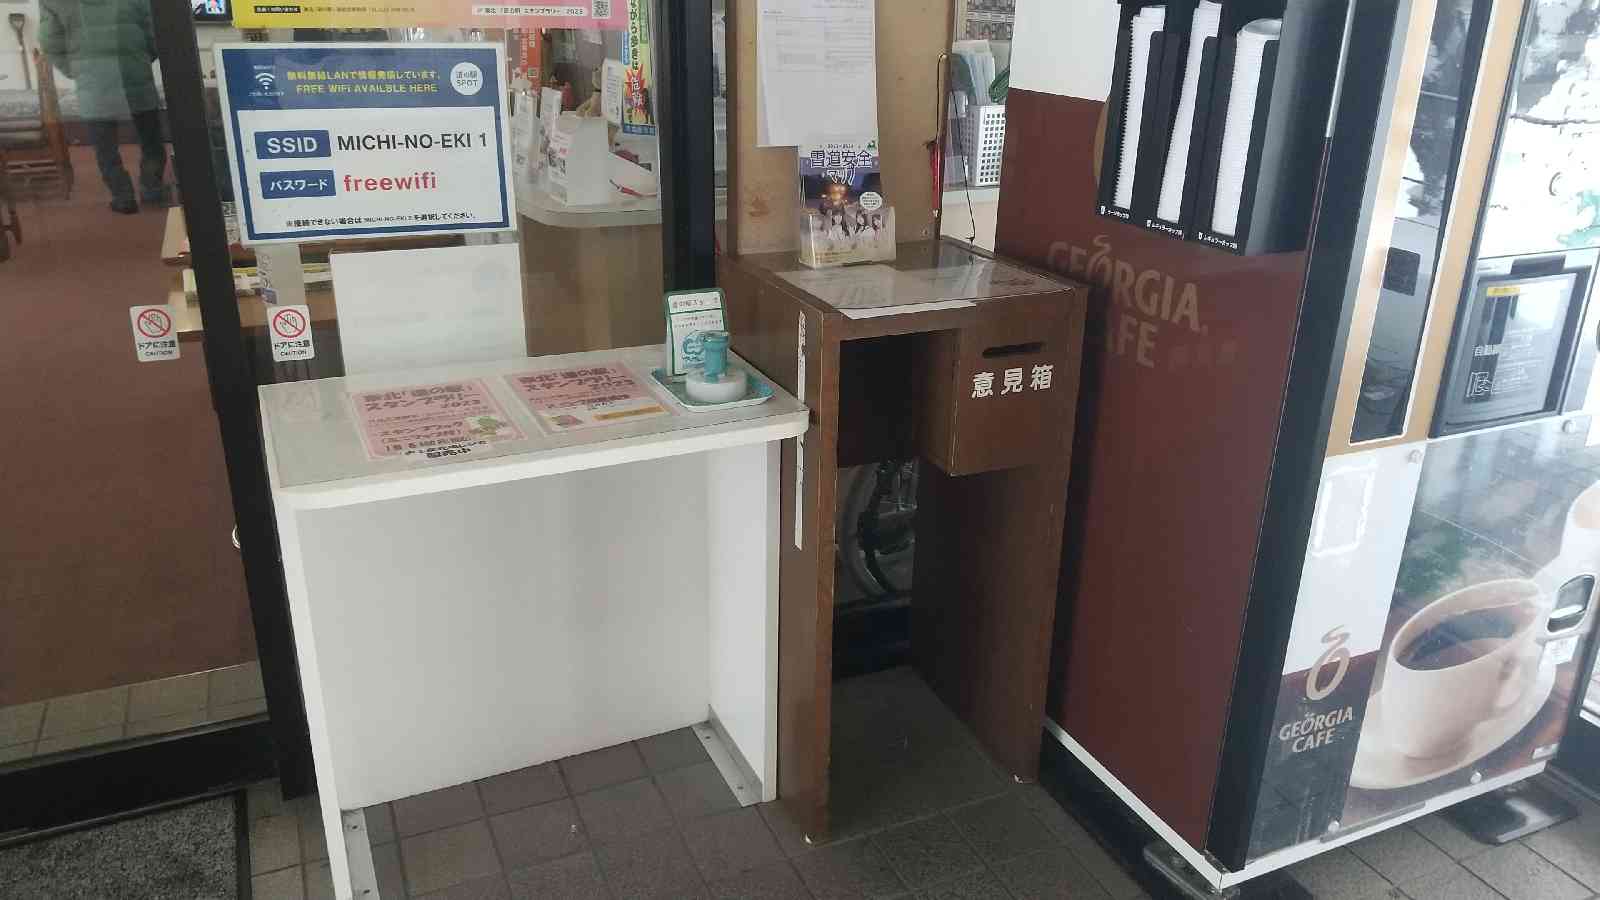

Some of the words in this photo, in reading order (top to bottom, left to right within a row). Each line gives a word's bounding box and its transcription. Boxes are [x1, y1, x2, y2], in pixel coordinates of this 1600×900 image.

[296, 84, 328, 95] FREE
[409, 82, 438, 93] HERE
[456, 79, 478, 88] SPOT
[266, 136, 318, 155] SSID
[337, 133, 472, 151] MICHI-NO-EKI
[479, 132, 487, 148] 1
[810, 149, 872, 168] 雪道安全
[270, 178, 329, 192] パスワード
[343, 171, 437, 193] freewifi
[137, 340, 176, 350] ドアに注意
[274, 340, 311, 350] ドアに注意
[972, 364, 1054, 399] 意見箱
[1292, 727, 1336, 753] CAFE
